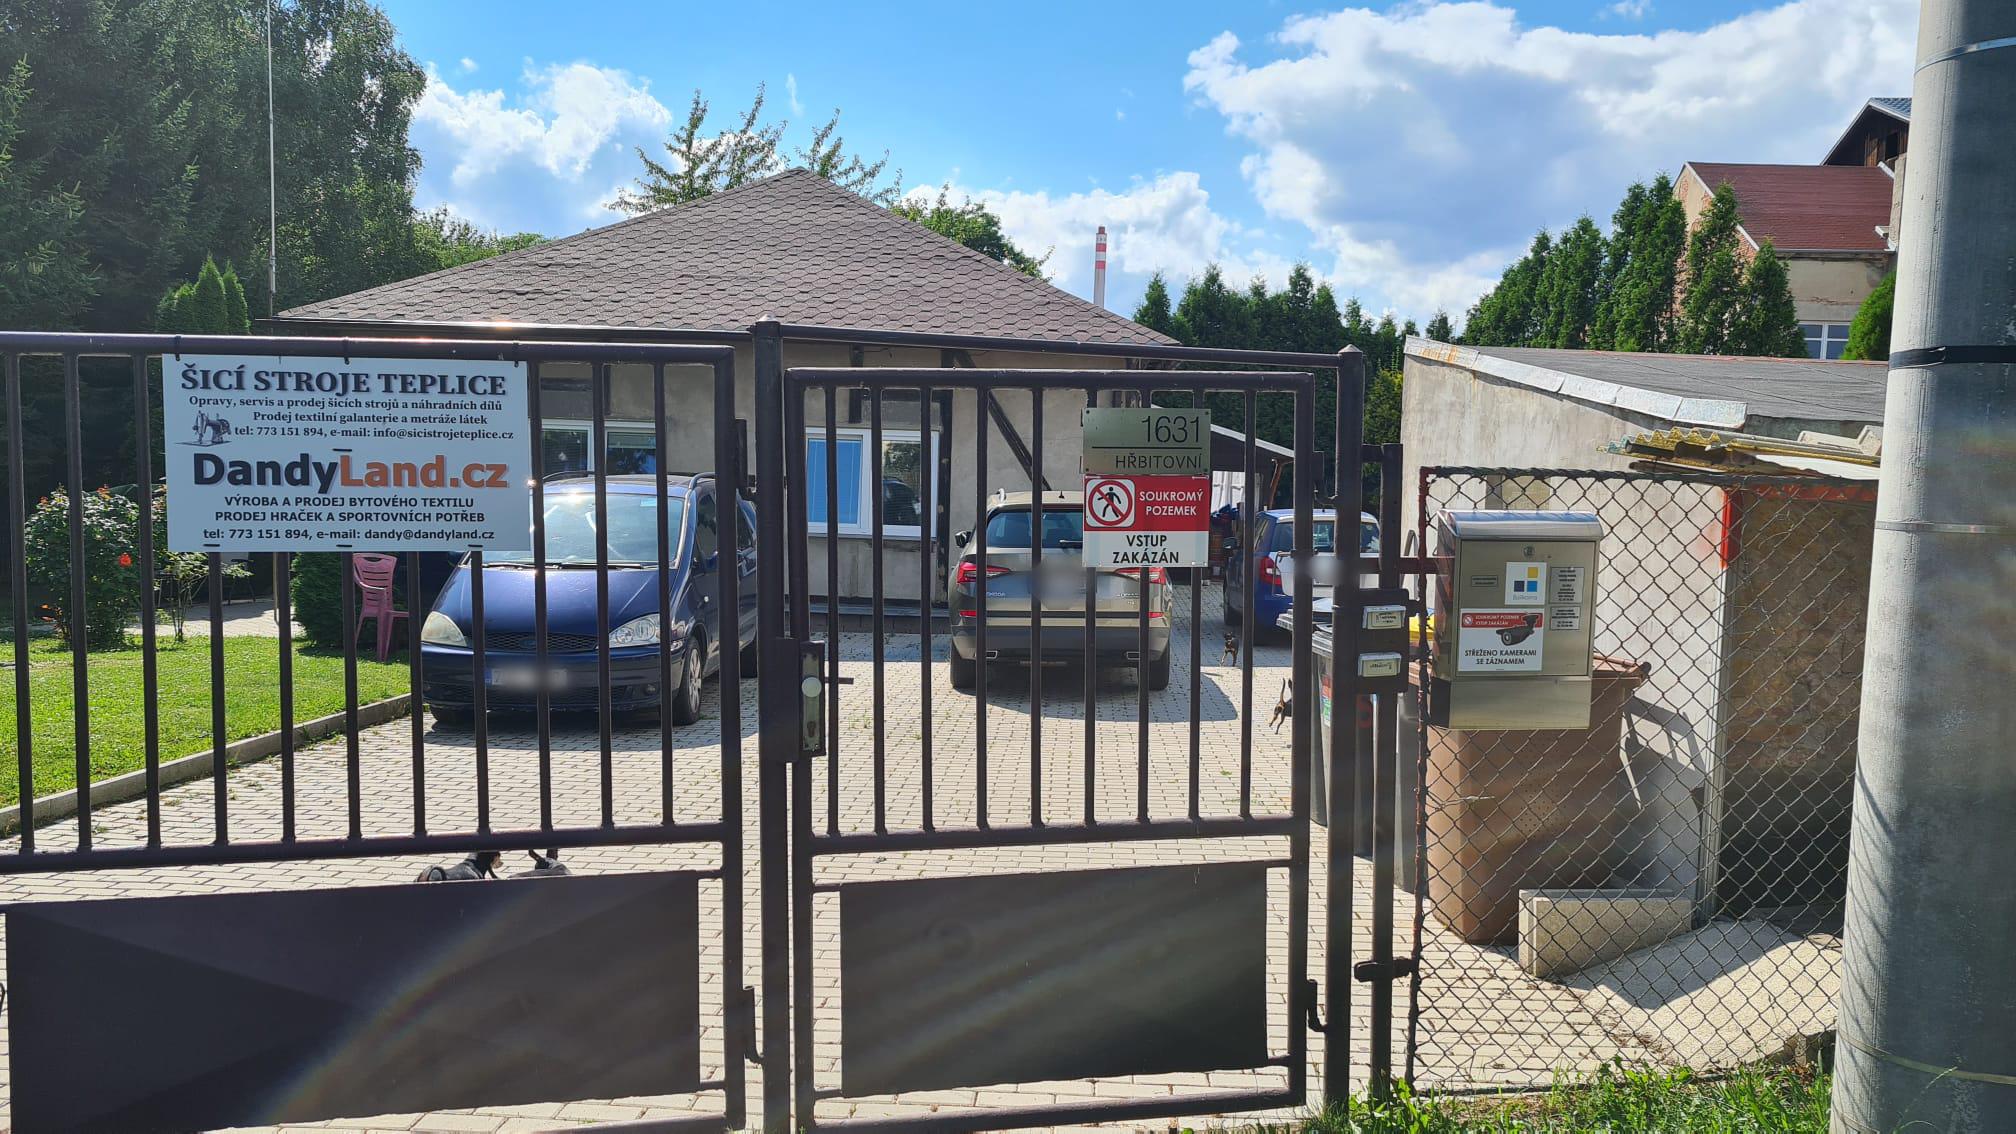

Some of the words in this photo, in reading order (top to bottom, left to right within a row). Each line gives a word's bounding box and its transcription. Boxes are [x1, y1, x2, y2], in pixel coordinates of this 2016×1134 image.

[181, 363, 246, 390] ŠICÍ
[254, 371, 370, 397] STROJE
[377, 373, 506, 395] TEPLICE
[189, 396, 236, 408] Opravy,
[240, 397, 274, 406] servis
[287, 397, 325, 409] prodej
[328, 397, 362, 408] šicích
[365, 399, 399, 410] strojů
[411, 399, 477, 410] náhradních
[480, 400, 502, 410] dílů
[253, 412, 292, 423] Prodej
[295, 412, 337, 422] textilní
[339, 413, 398, 424] galanterie
[411, 415, 456, 424] metráže
[459, 415, 488, 424] látek
[235, 426, 254, 435] tel:
[256, 427, 277, 435] 773
[280, 427, 299, 436] 151
[303, 427, 327, 437] 894,
[330, 428, 370, 437] e-mail:
[373, 427, 514, 440] info@sicistrojeteplice.cz
[1141, 415, 1199, 443] 1631
[1115, 452, 1202, 469] HŘBITOVNÍ
[193, 453, 508, 494] DandyLand.cz
[224, 494, 278, 507] VÝROBA
[282, 497, 291, 506] A
[295, 497, 345, 507] PRODEJ
[349, 495, 418, 507] BYTOVÉHO
[421, 497, 474, 508] TEXTILU
[1139, 488, 1204, 502] SOUKROMÝ
[215, 511, 266, 521] PRODEJ
[271, 509, 323, 522] HRAČEK
[326, 512, 335, 521] A
[338, 509, 432, 522] SPORTOVNÍCH
[436, 510, 485, 522] POTŘEB
[1146, 505, 1197, 516] POZEMEK
[203, 529, 224, 539] tel:
[229, 529, 253, 539] 773
[257, 529, 283, 539] 151
[285, 529, 312, 540] 894,
[316, 529, 361, 539] e-mail:
[365, 529, 495, 541] dandy@dandyland.cz
[1126, 534, 1167, 547] VSTUP
[1112, 548, 1179, 564] ZAKÁZÁN
[1464, 649, 1498, 657] STŘEŽENO
[1500, 649, 1537, 657] KAMERAMI
[1485, 656, 1525, 665] ZÁZNAMEM
